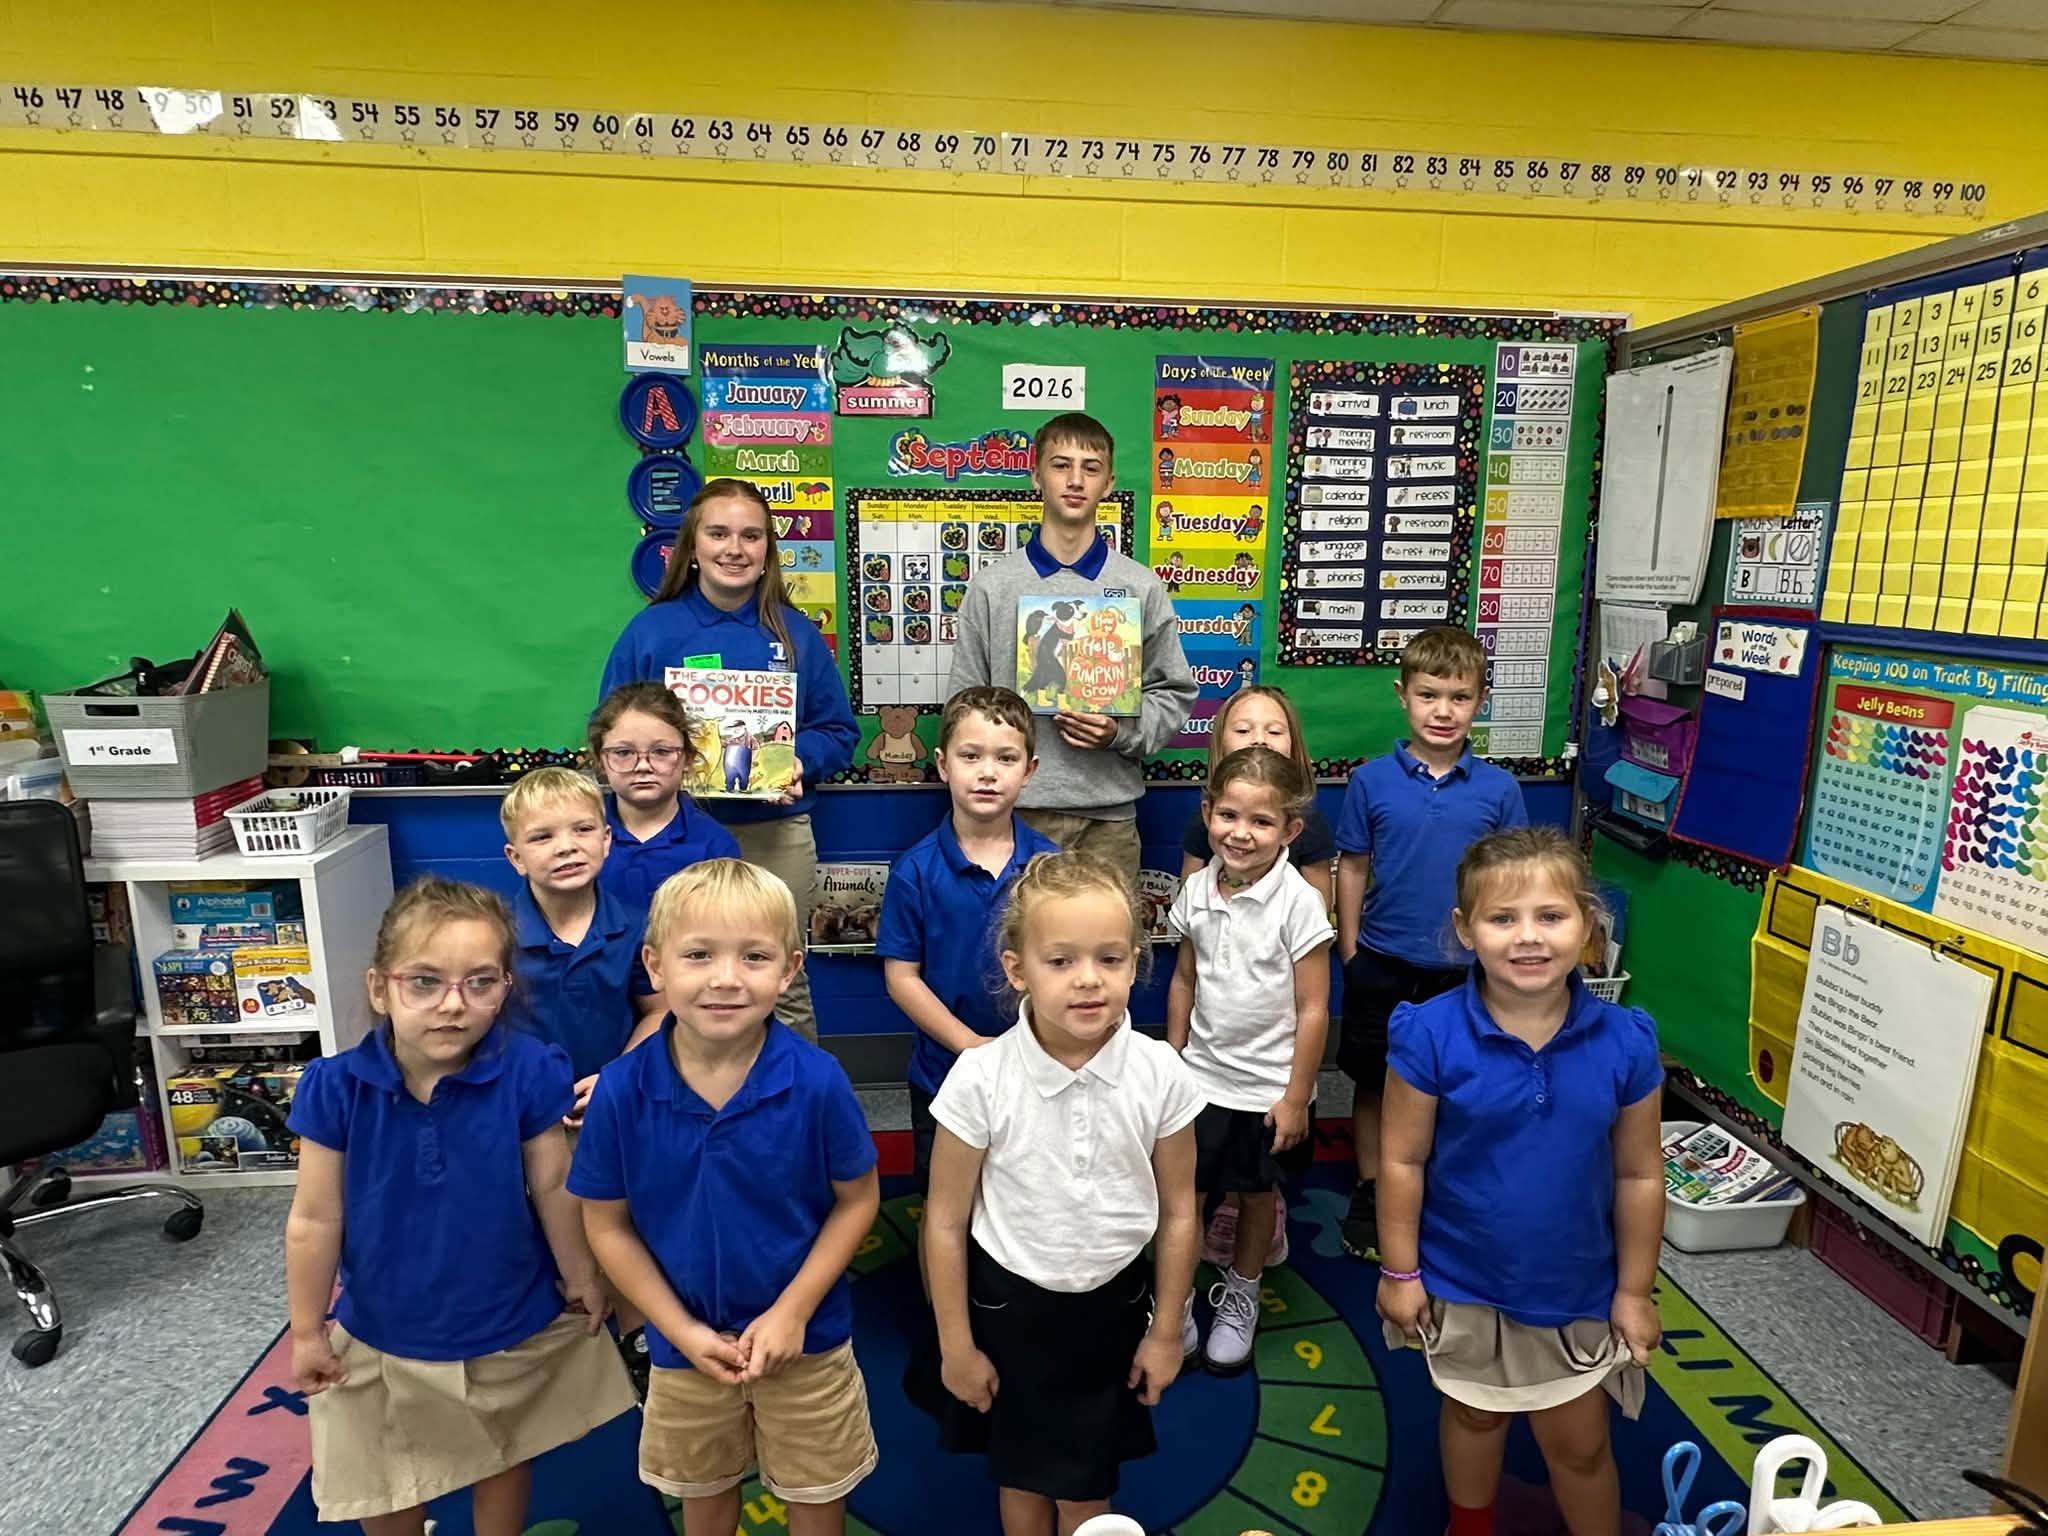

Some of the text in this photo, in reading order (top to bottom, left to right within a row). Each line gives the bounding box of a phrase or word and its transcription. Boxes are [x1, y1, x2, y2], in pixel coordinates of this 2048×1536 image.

[13, 86, 1986, 202] 46 47 48 51 52 54 56 58 60 62 64 66 68 70 72 74 76 78 80 82 84 86 88 90 92 94 96 98 100
[1875, 280, 2039, 332] 1 2 3 4 5 6
[1866, 319, 2036, 367] 11 12 13 14 15 16
[640, 349, 675, 362] Vowels
[704, 351, 760, 368] Months
[764, 356, 773, 366] of
[776, 357, 790, 366] the
[1501, 354, 1515, 371] 10
[1162, 363, 1197, 381] Days
[1231, 367, 1270, 382] Week
[1862, 355, 2032, 398] 21 22 23 24 25 26
[726, 382, 807, 409] January
[1012, 378, 1073, 399] 2026
[847, 396, 925, 408] summer
[1337, 399, 1371, 409] arrival
[1424, 400, 1449, 410] lunch
[1496, 391, 1516, 407] 20
[643, 386, 680, 433] A
[1179, 405, 1251, 431] Sunday
[720, 414, 811, 441] February
[1339, 429, 1371, 439] morning
[1409, 429, 1451, 439] restroom
[1492, 427, 1512, 443] 30
[1338, 438, 1371, 448] meeting
[736, 449, 799, 471] March
[908, 440, 1037, 478] Septem
[1329, 457, 1366, 468] morning
[1416, 460, 1446, 470] music
[1174, 458, 1252, 483] Monday
[1335, 466, 1359, 475] work
[1489, 462, 1508, 478] 40
[652, 471, 682, 513] E
[1325, 491, 1366, 501] calendar
[1415, 491, 1449, 501] recess
[1487, 497, 1507, 513] 50
[1172, 513, 1248, 536] Tuesday
[1404, 518, 1449, 528] restroom
[1780, 515, 1821, 530] Letter?
[1324, 542, 1364, 552] language
[1484, 533, 1504, 549] 60
[1334, 550, 1353, 559] arts
[1402, 547, 1448, 556] rest time
[1154, 565, 1261, 588] Wednesday
[1327, 573, 1363, 584] phonics
[1399, 574, 1445, 587] assembly
[1482, 566, 1500, 581] 70
[1741, 569, 1750, 587] B
[1329, 605, 1355, 614] math
[1403, 603, 1445, 615] pack up
[1479, 600, 1498, 616] 80
[1176, 616, 1248, 638] hursday
[1321, 632, 1359, 642] centers
[1742, 630, 1777, 646] Words
[1082, 639, 1116, 656] Help
[1741, 650, 1771, 665] Week
[670, 671, 791, 685] THE COW LOVES
[1071, 661, 1124, 685] PUMPKIN
[1192, 666, 1233, 688] iday
[1833, 654, 1881, 679] Keeping
[1885, 662, 1909, 680] 100
[1912, 668, 1928, 681] on
[1934, 666, 1971, 687] Track
[1976, 671, 1997, 695] By
[1707, 674, 1743, 691] prepared
[1857, 697, 1925, 719] Jelly Beans
[88, 744, 151, 757] 1st Grade
[824, 875, 875, 894] Animals
[197, 896, 246, 906] Alphabet
[1821, 925, 1861, 966] Bb
[171, 1091, 194, 1104] 48
[1309, 1403, 1342, 1437] 7
[1290, 1469, 1329, 1508] 8
